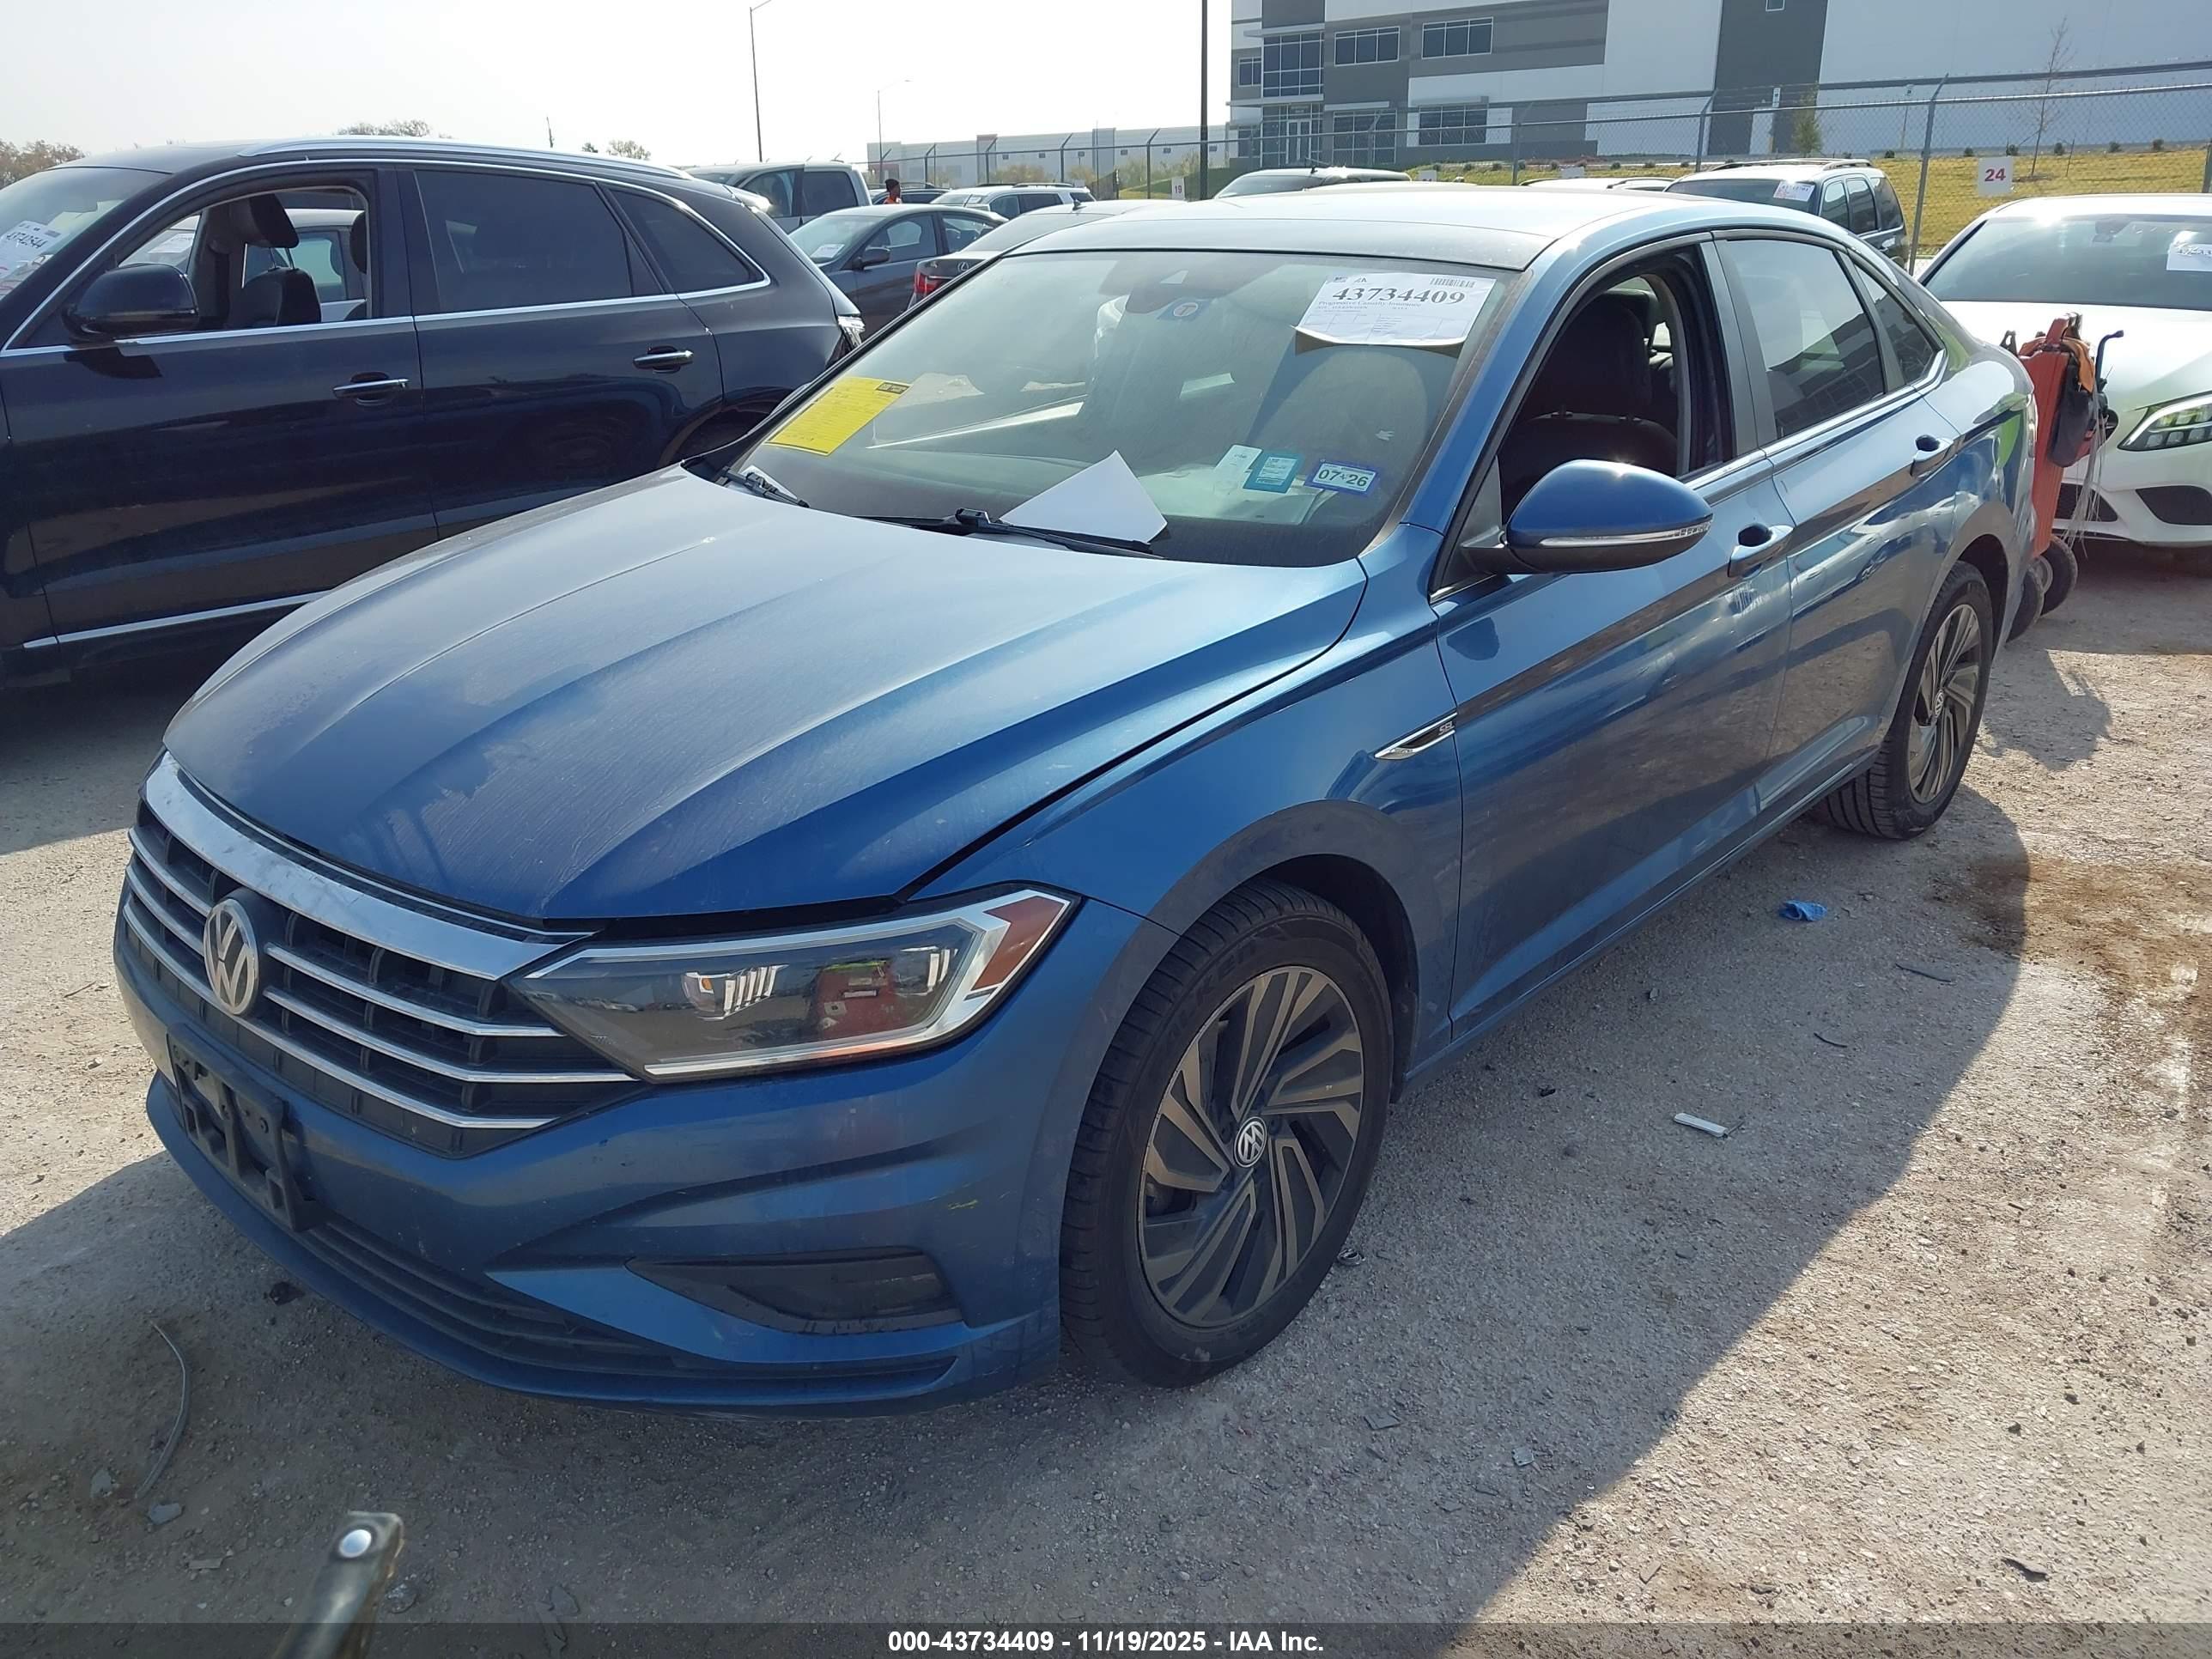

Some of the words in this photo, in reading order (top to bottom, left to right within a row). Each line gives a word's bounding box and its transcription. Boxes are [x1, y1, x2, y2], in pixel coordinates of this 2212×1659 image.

[1984, 167, 2007, 182] 24
[1174, 185, 1182, 194] 19
[1332, 287, 1466, 305] 43734409
[1318, 469, 1341, 481] 07
[1346, 474, 1369, 487] 26
[1438, 720, 1455, 736] SEL
